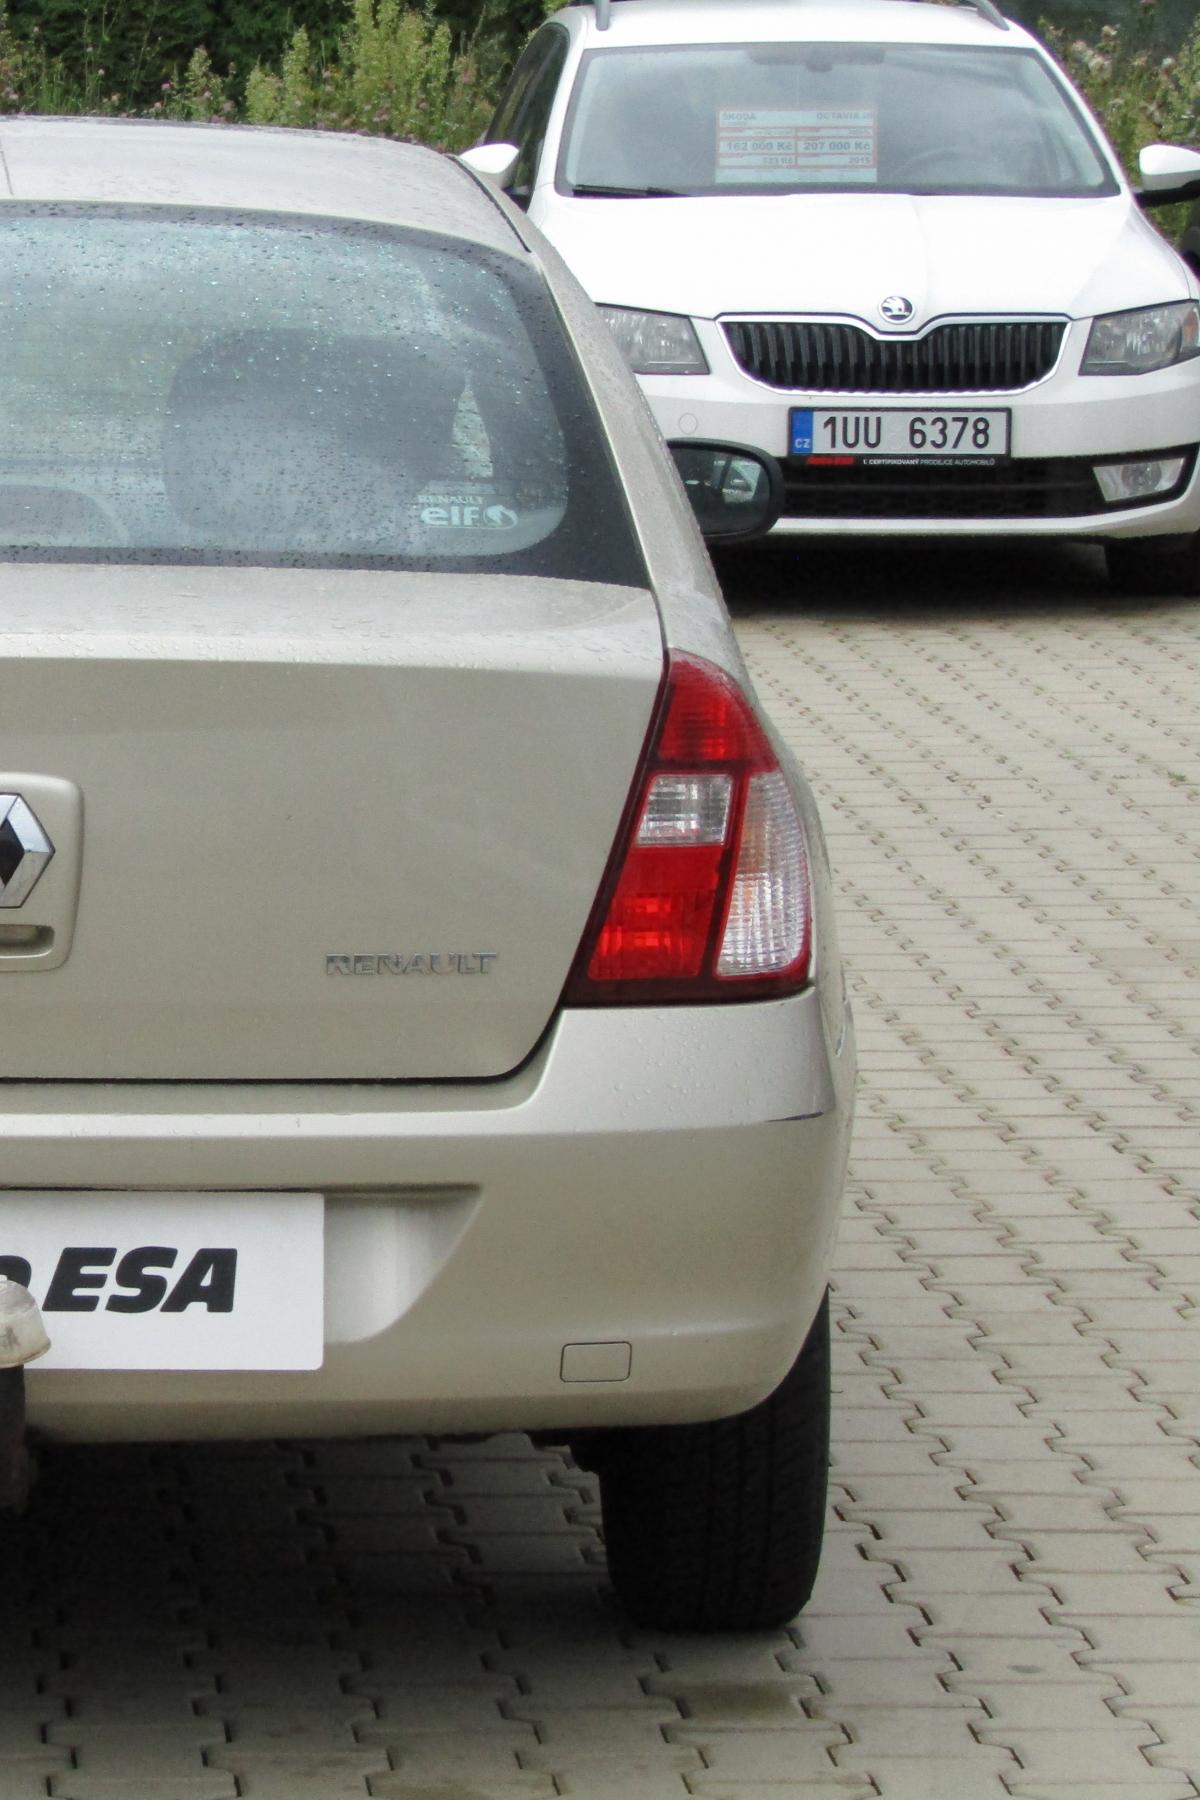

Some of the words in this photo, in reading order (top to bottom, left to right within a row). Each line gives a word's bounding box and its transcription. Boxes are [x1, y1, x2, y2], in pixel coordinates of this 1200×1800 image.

[816, 111, 859, 121] OCTAVIA
[803, 142, 825, 152] 207
[829, 142, 850, 152] 000
[854, 140, 871, 152] Kč
[823, 416, 882, 449] 1UU
[908, 416, 990, 450] 6378
[794, 439, 810, 449] CZ
[417, 494, 484, 505] RENAULT
[325, 951, 498, 976] RENAULT
[41, 1246, 239, 1313] ESA
